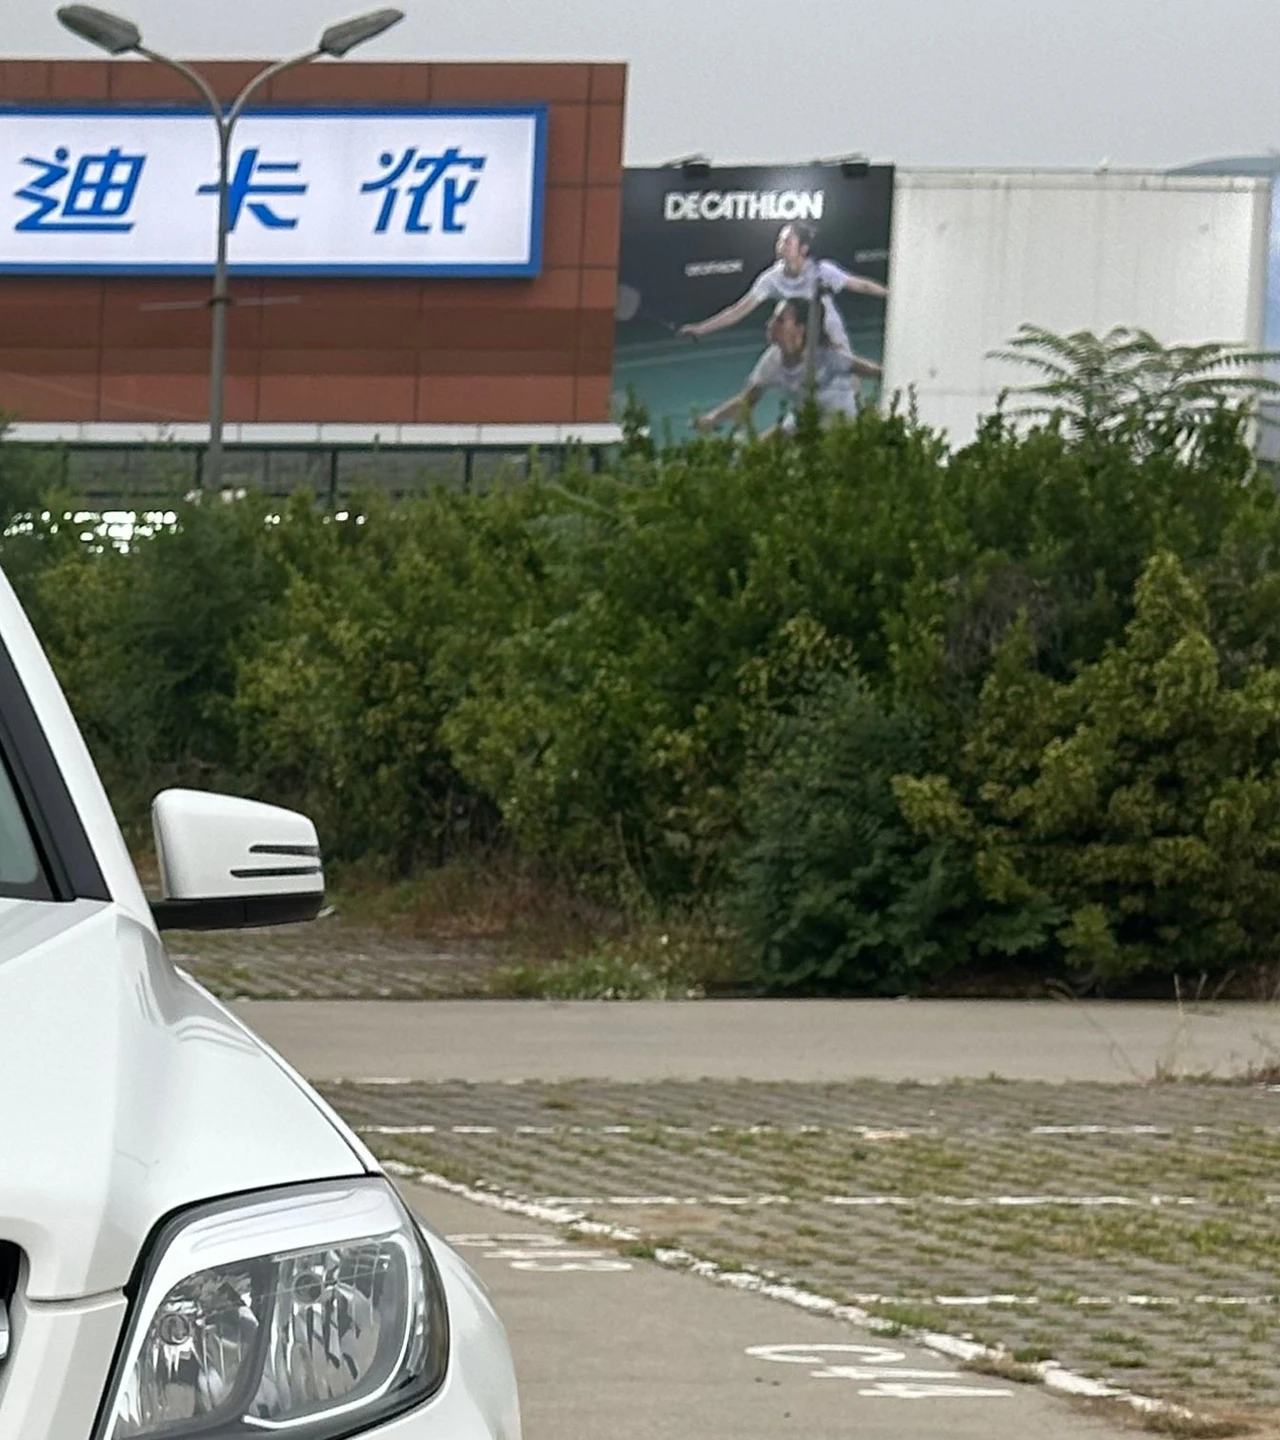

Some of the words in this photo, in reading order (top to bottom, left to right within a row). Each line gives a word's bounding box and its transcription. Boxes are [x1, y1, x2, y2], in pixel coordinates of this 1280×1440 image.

[13, 146, 486, 234] 迪卡侬
[663, 189, 824, 221] DECATHLON
